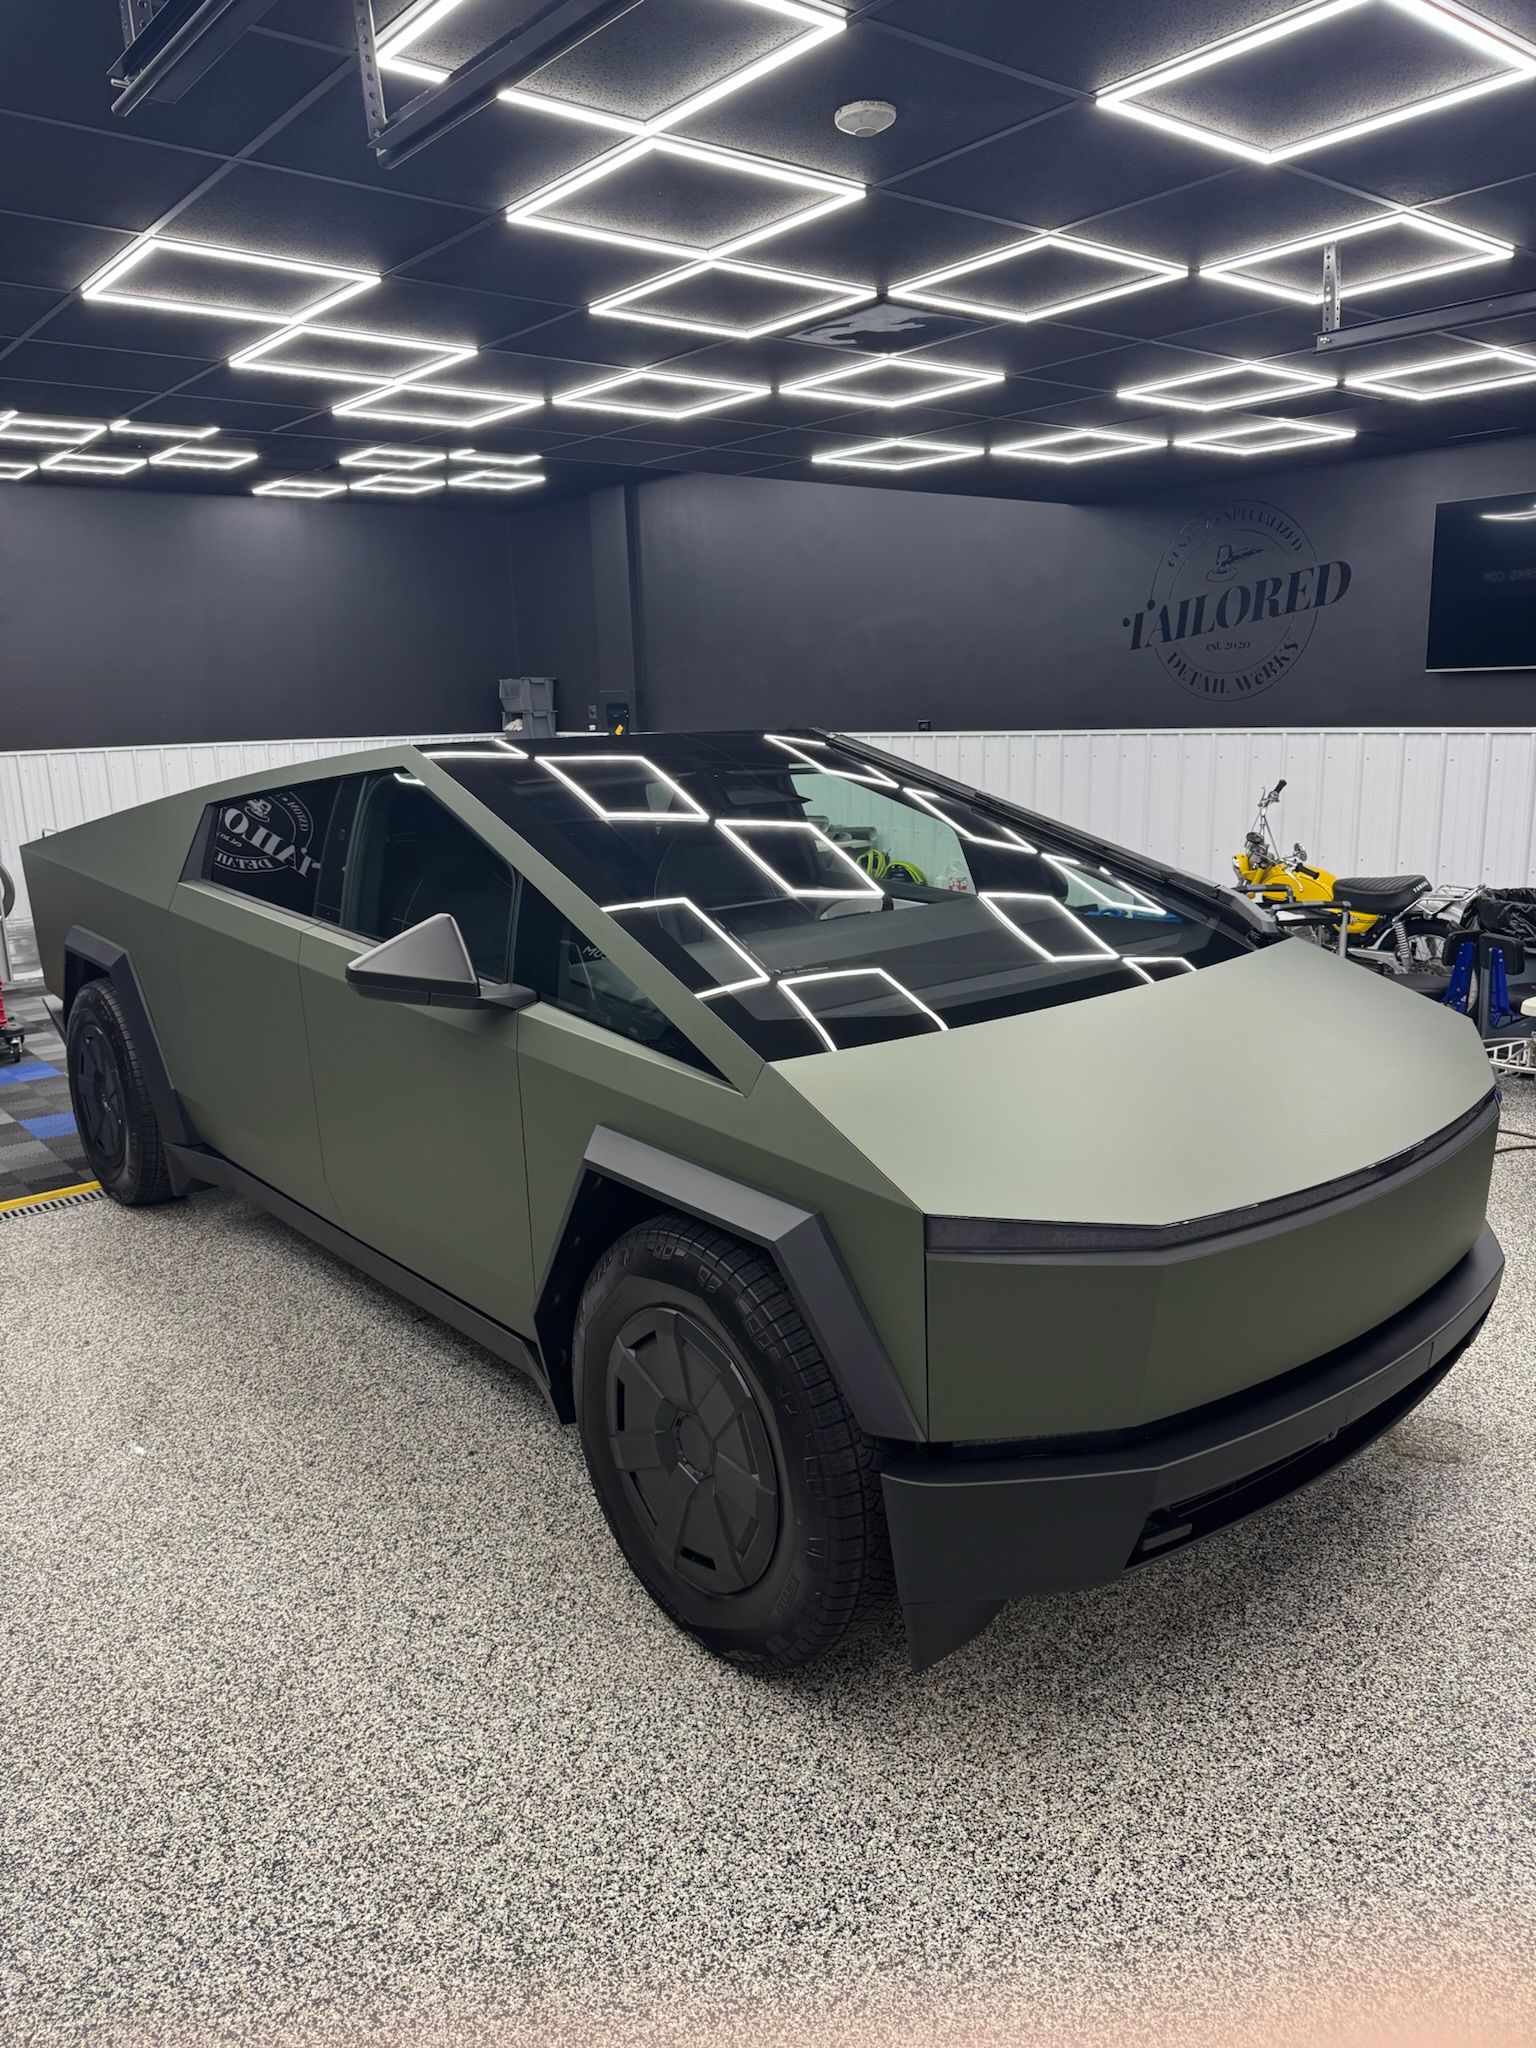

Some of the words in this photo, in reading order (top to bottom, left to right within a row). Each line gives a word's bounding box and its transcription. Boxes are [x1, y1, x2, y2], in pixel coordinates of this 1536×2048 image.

[1122, 560, 1352, 651] TAILORED
[1223, 640, 1250, 650] 2020
[1166, 651, 1231, 694] DETAIL
